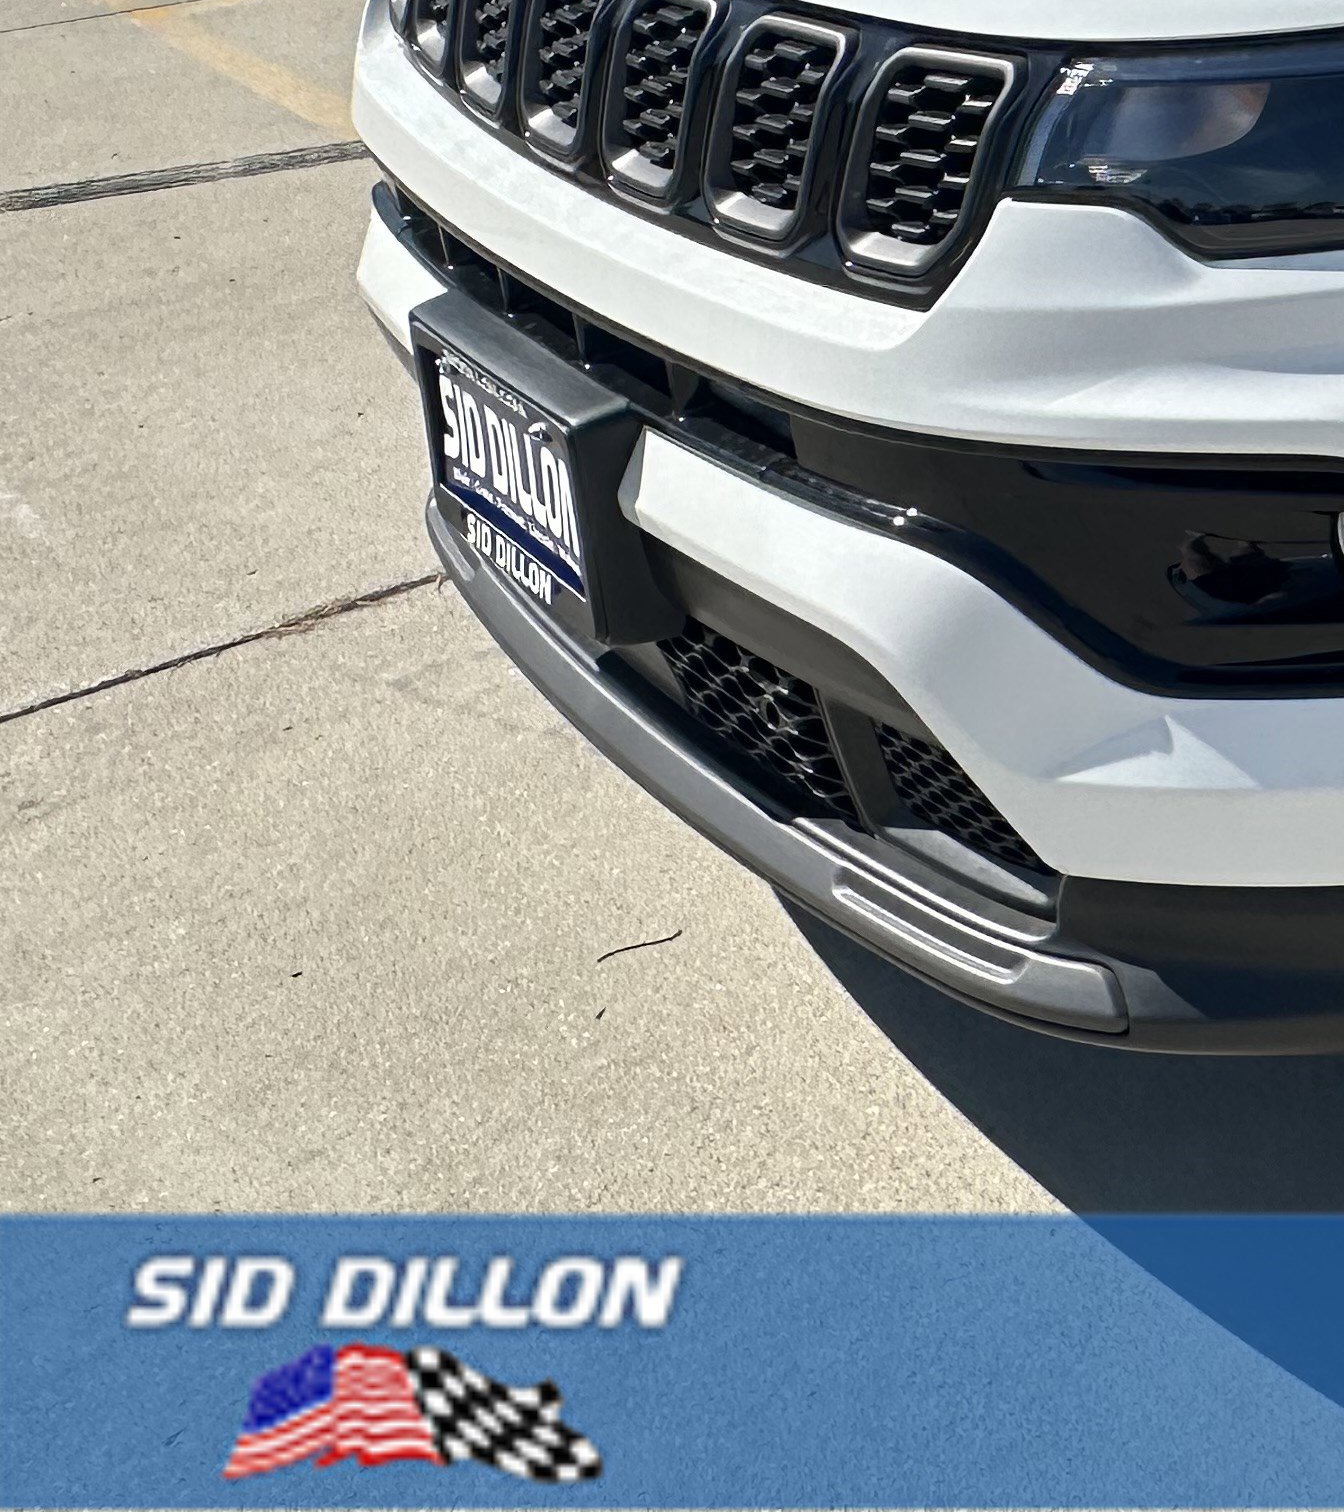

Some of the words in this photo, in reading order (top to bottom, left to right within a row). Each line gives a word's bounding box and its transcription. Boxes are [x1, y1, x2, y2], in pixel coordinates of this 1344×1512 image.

[438, 374, 486, 478] SID
[484, 404, 580, 557] DILLON
[466, 513, 493, 556] SID
[496, 534, 551, 605] DILLON
